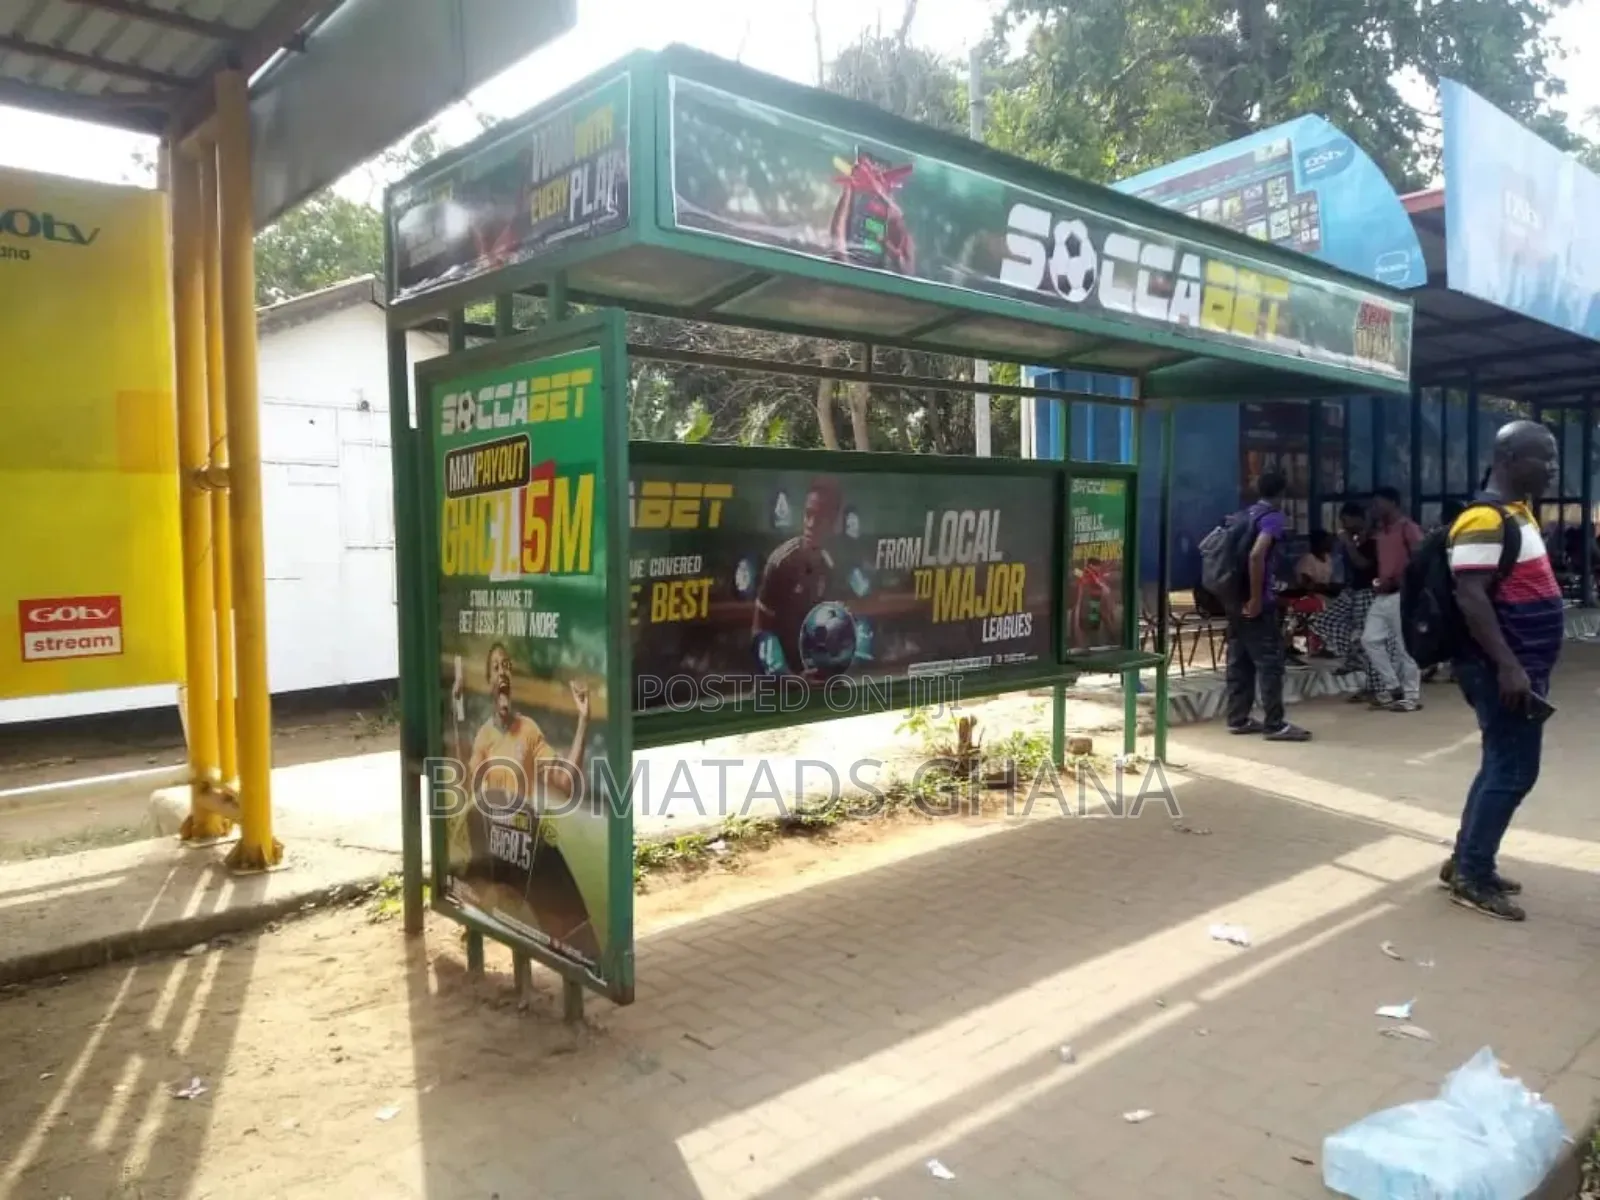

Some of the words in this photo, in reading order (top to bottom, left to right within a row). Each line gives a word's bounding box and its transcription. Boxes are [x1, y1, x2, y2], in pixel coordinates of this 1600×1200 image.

[876, 537, 922, 570] FROM
[922, 509, 1003, 566] LOCAL
[650, 556, 702, 577] COVERED
[651, 577, 713, 623] BEST
[914, 570, 933, 600] TO
[932, 562, 1026, 624] MAJOR
[475, 611, 494, 635] LESS
[507, 611, 526, 637] WIN
[529, 612, 560, 638] MORE
[981, 612, 1033, 643] LEAGUES
[33, 636, 113, 652] stream
